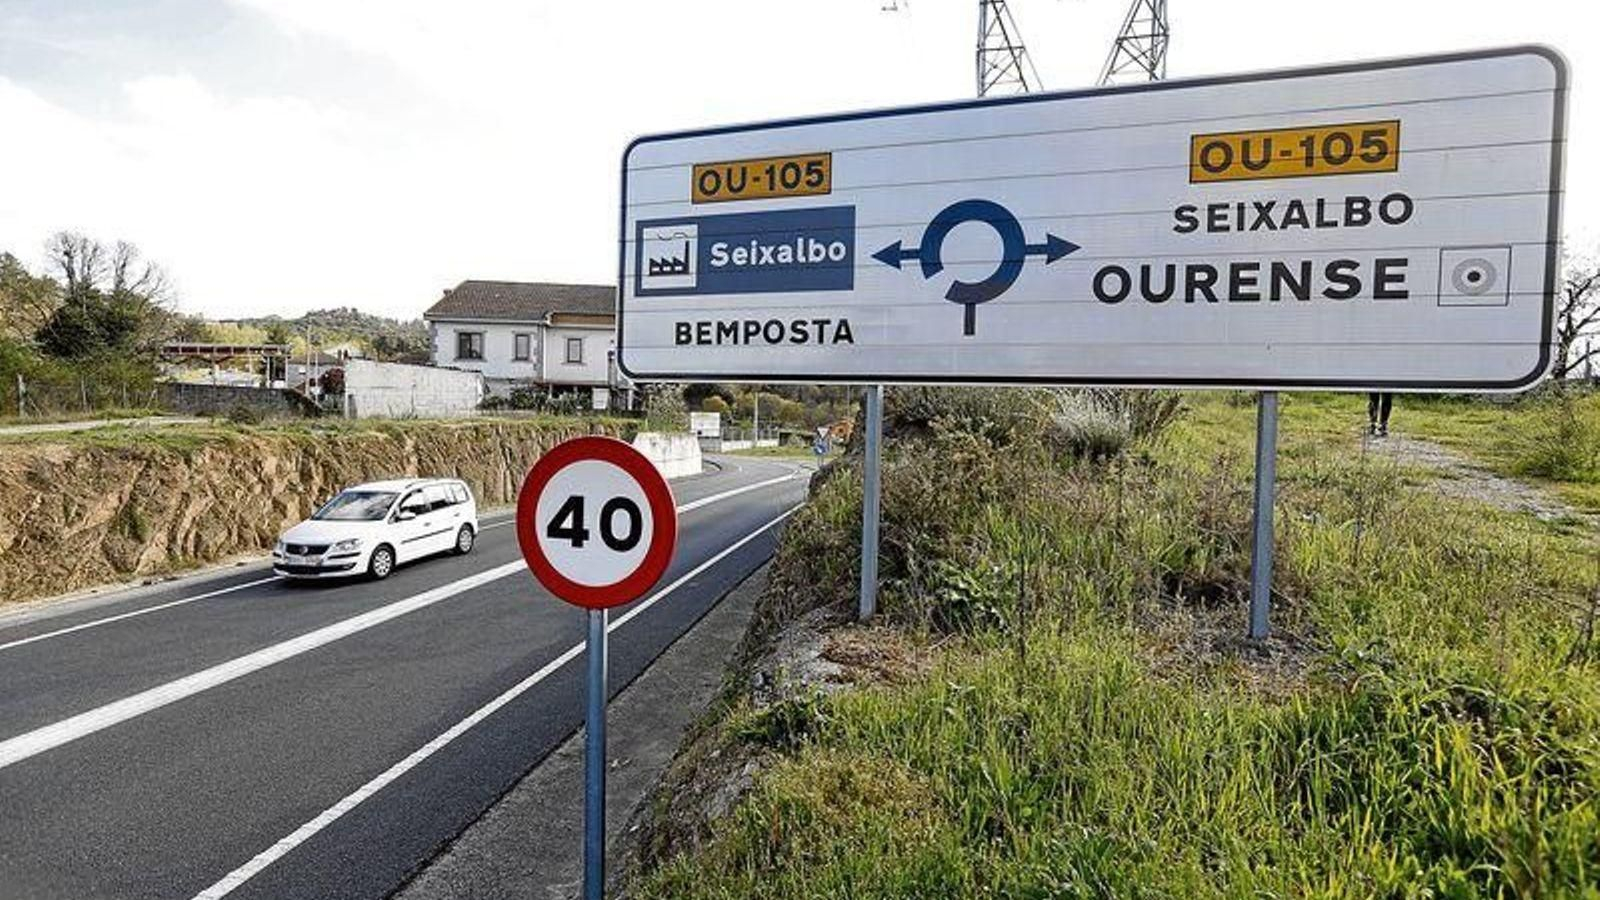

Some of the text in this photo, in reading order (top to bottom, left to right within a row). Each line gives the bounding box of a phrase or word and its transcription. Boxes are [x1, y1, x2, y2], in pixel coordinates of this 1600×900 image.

[1198, 128, 1389, 174] OU-105
[698, 160, 824, 196] OU-105
[1172, 192, 1414, 234] SEIXALBO
[710, 237, 847, 268] Seixalbo
[1092, 257, 1410, 304] OURENSE
[675, 318, 855, 346] BEMPOSTA
[547, 495, 643, 552] 40
